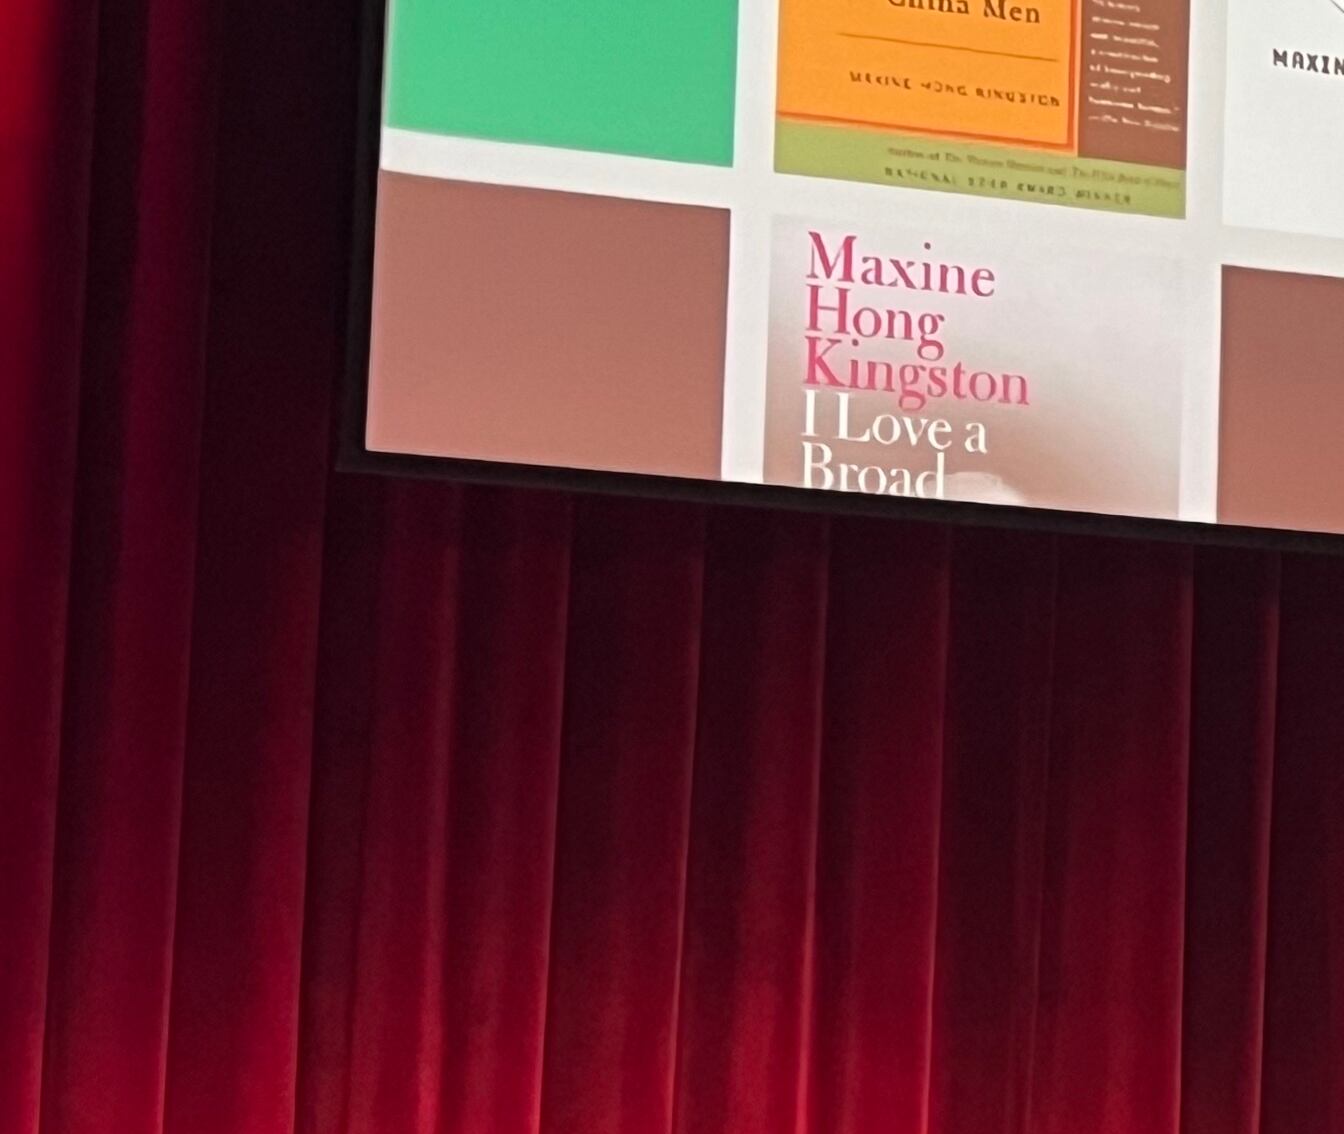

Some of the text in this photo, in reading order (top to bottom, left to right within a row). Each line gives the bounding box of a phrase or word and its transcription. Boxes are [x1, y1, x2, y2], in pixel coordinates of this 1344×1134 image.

[984, 0, 1040, 23] Men
[806, 230, 995, 297] Maxine
[805, 284, 945, 361] Hong
[804, 335, 1030, 412] Kingston
[801, 389, 987, 453] I Love a
[801, 441, 945, 499] Broad
